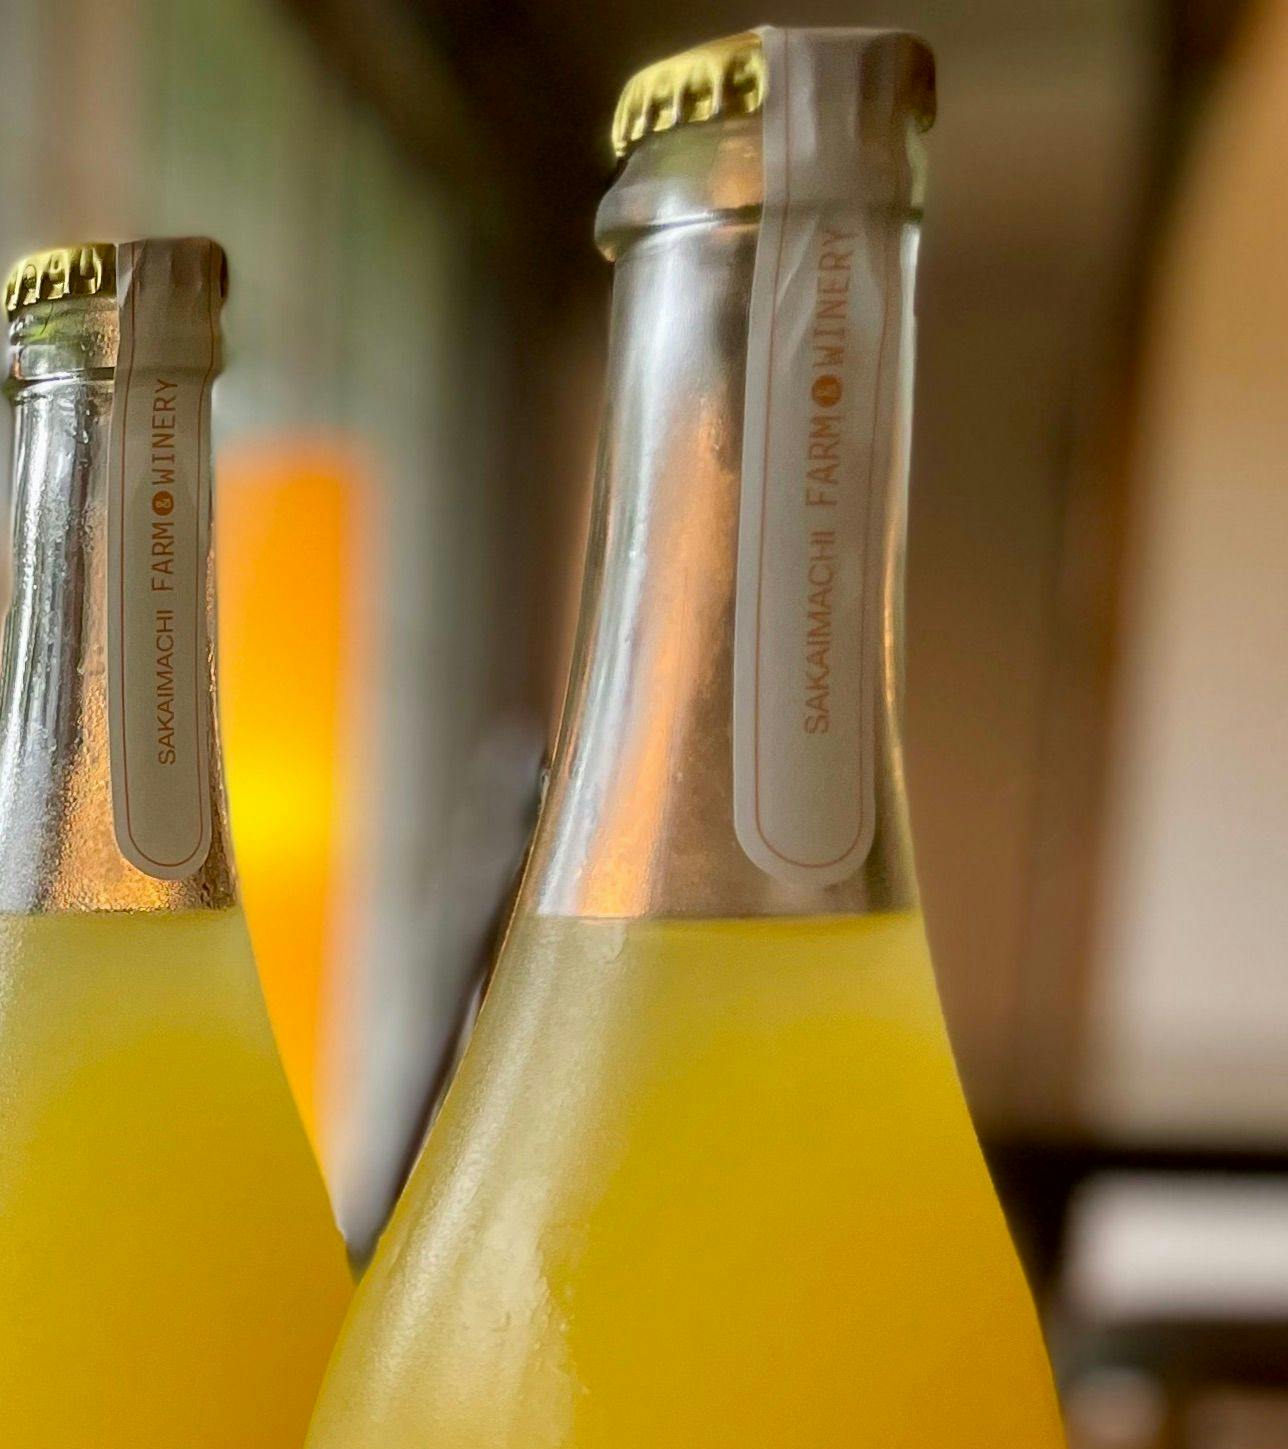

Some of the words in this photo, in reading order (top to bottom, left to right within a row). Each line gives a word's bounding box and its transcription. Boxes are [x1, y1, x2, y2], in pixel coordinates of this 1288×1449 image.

[811, 228, 860, 367] WINERY
[151, 378, 178, 485] WINERY
[805, 414, 842, 507] FARM
[151, 522, 174, 592] FARM
[156, 610, 176, 765] SAKAIMACHI
[804, 531, 835, 735] SAKAIMACHI
